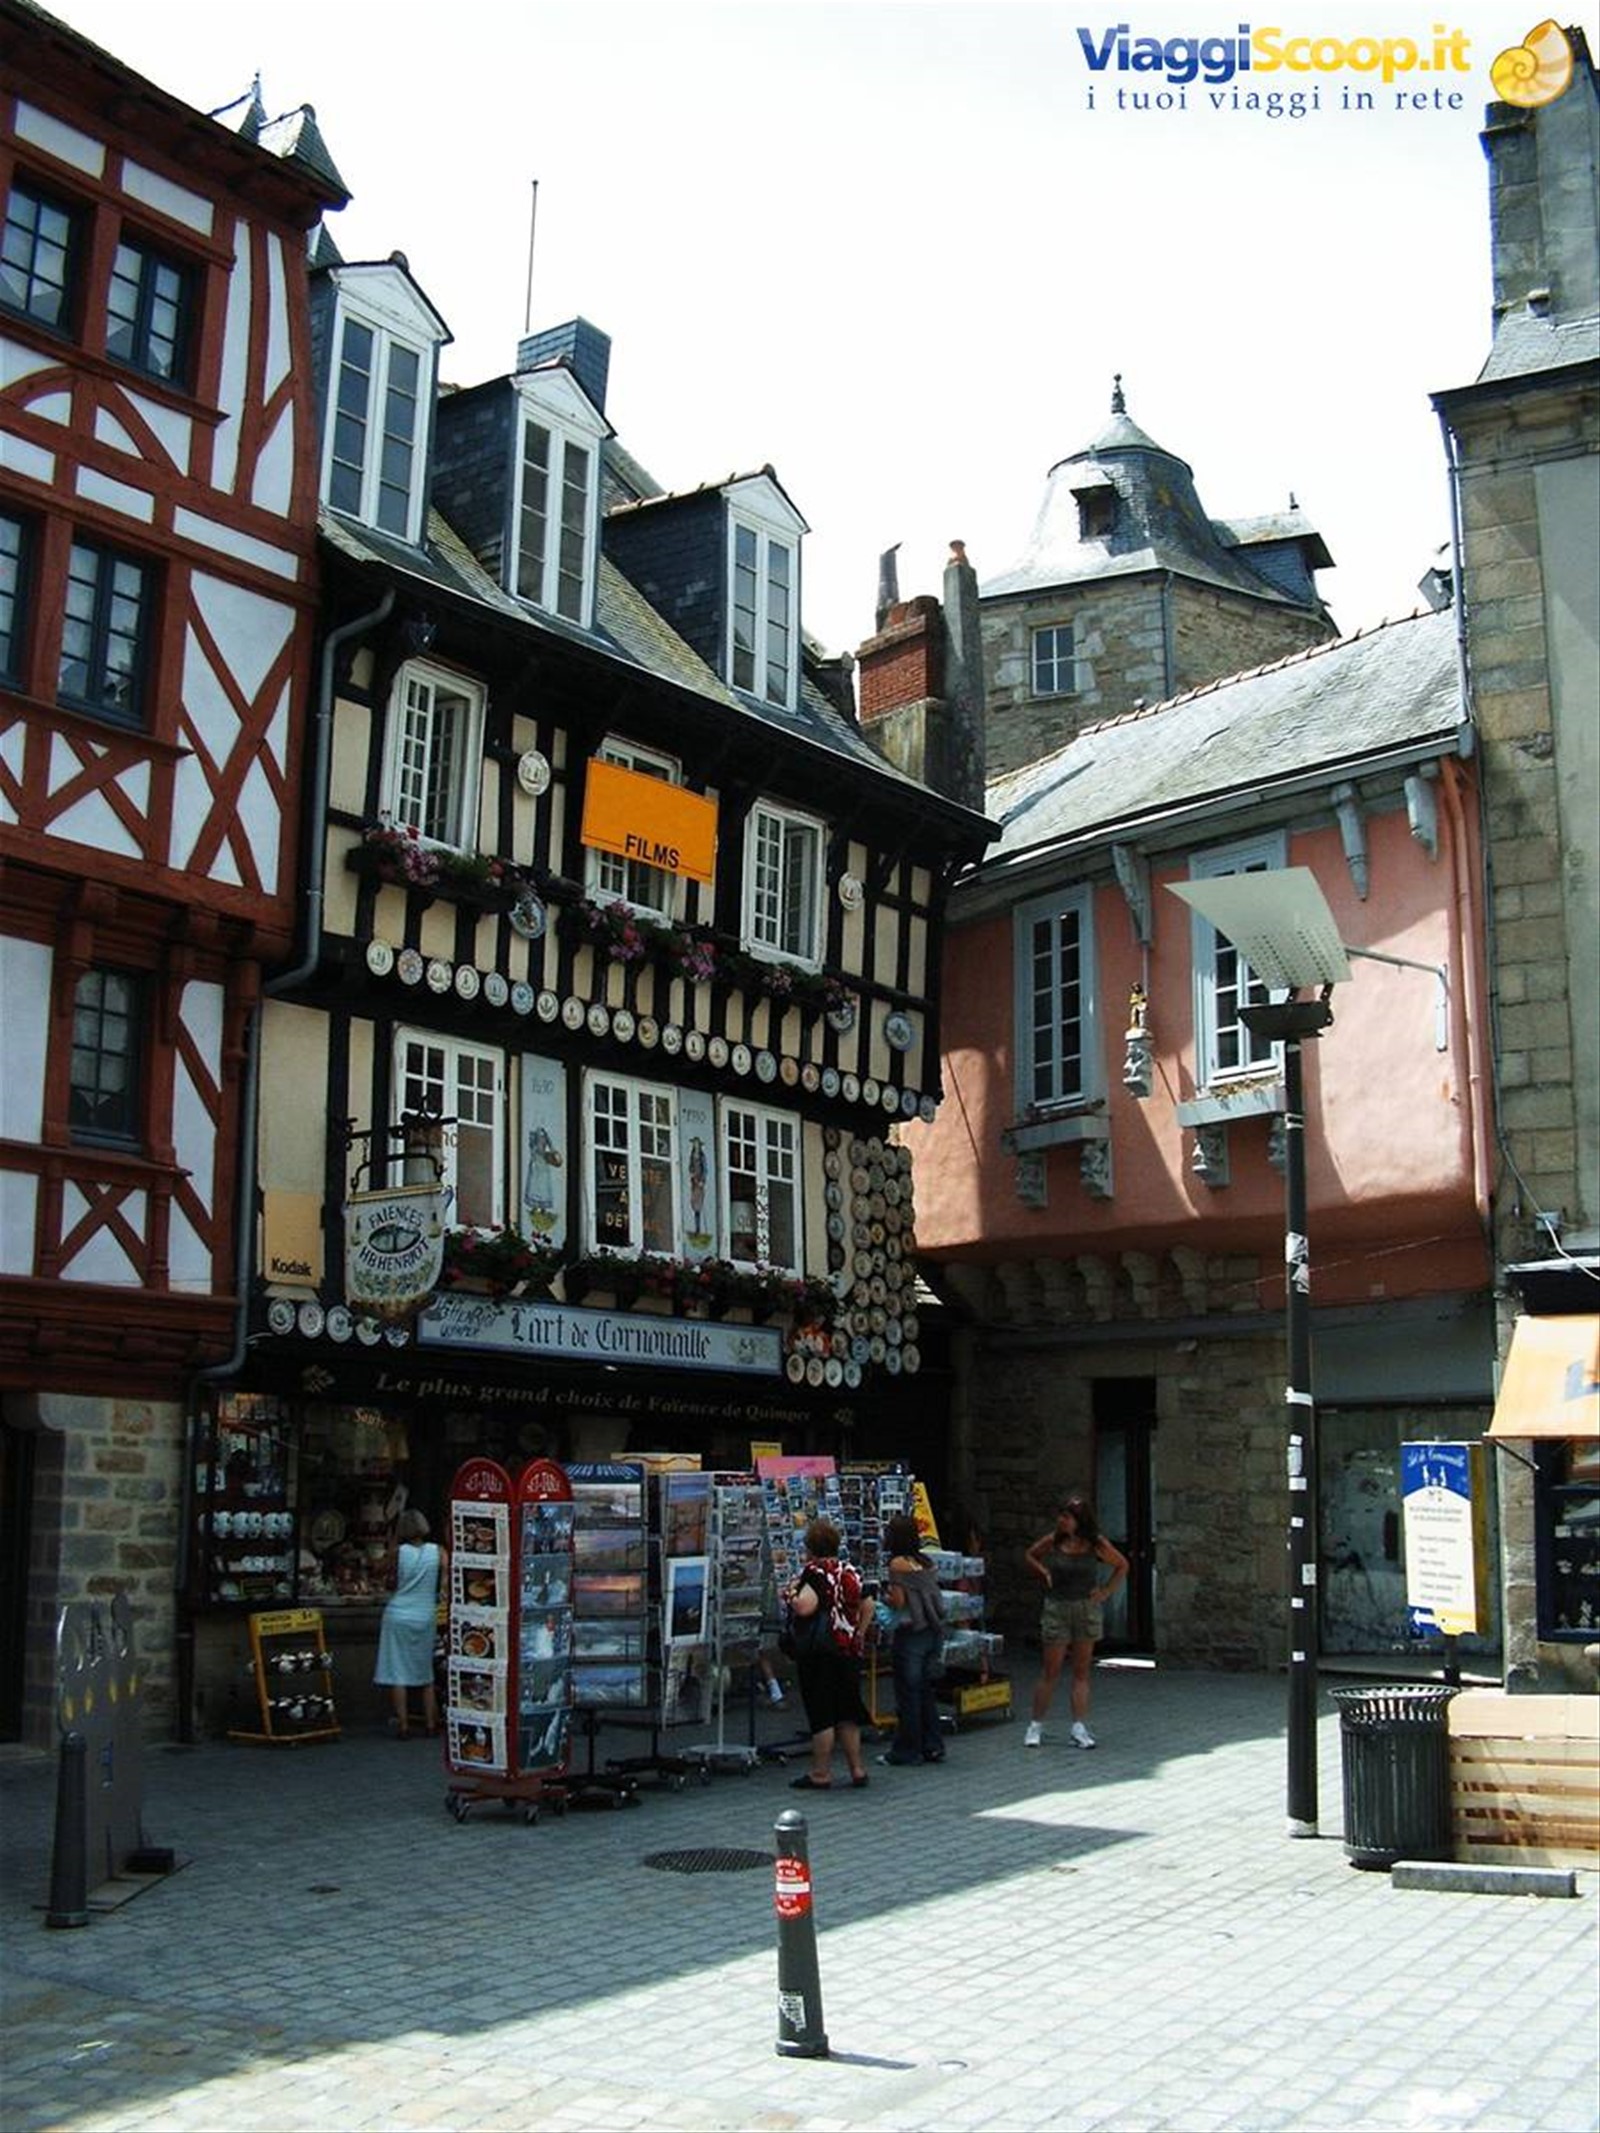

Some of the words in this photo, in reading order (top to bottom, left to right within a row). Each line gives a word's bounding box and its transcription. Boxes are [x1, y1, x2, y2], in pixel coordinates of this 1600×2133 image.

[625, 833, 680, 869] FILMS
[271, 1257, 313, 1277] Kodak
[571, 1322, 589, 1348] de
[596, 1319, 711, 1359] Cornouaille
[376, 1373, 411, 1392] Le
[417, 1378, 473, 1398] plus
[479, 1386, 549, 1403] grand
[556, 1389, 613, 1409] choix
[618, 1394, 641, 1410] de
[722, 1402, 742, 1418] de
